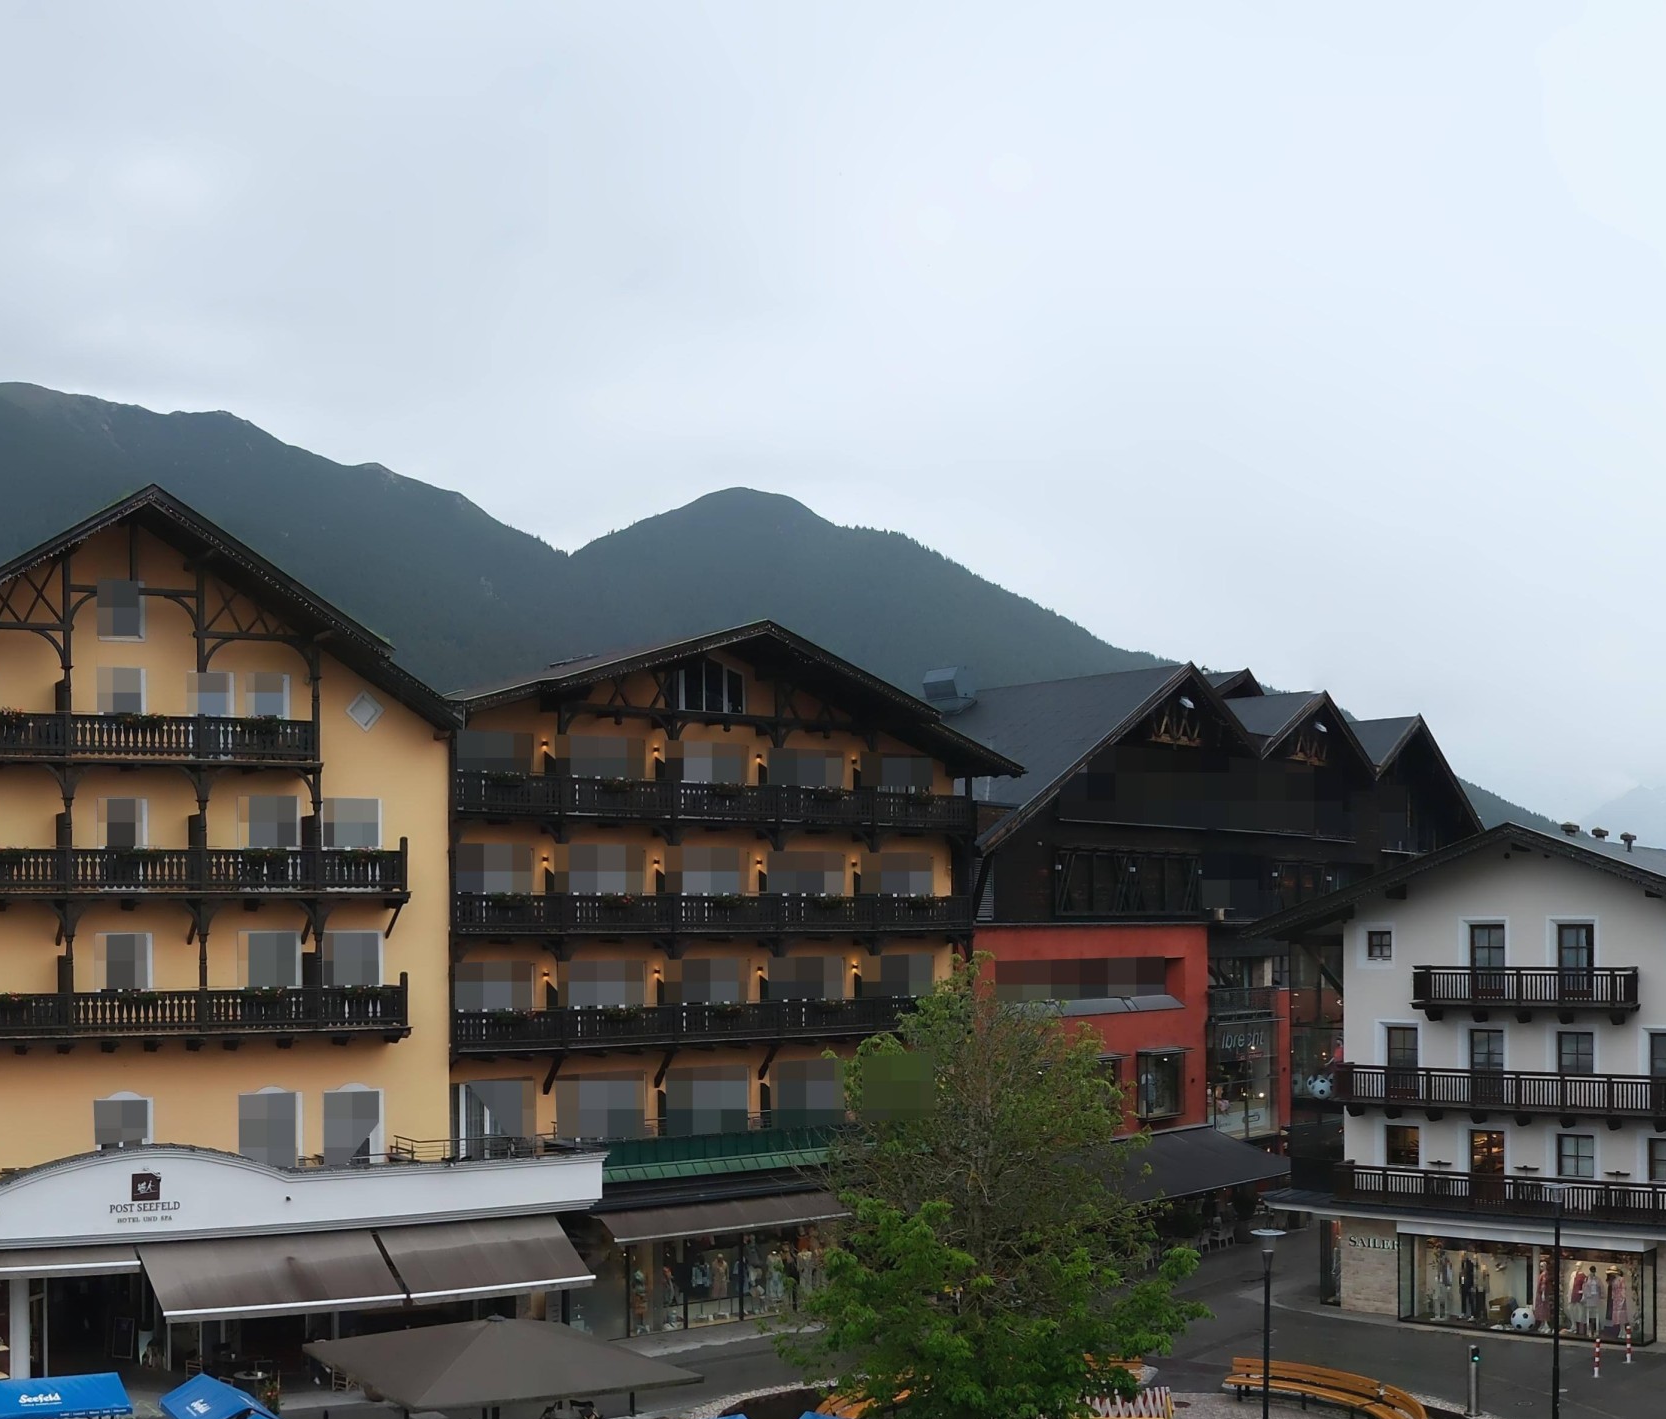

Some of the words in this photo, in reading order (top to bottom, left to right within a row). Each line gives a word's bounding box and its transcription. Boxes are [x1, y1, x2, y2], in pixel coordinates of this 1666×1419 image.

[110, 1204, 134, 1213] POST
[137, 1201, 180, 1212] SEEFELD
[18, 1392, 62, 1405] Seefeld
